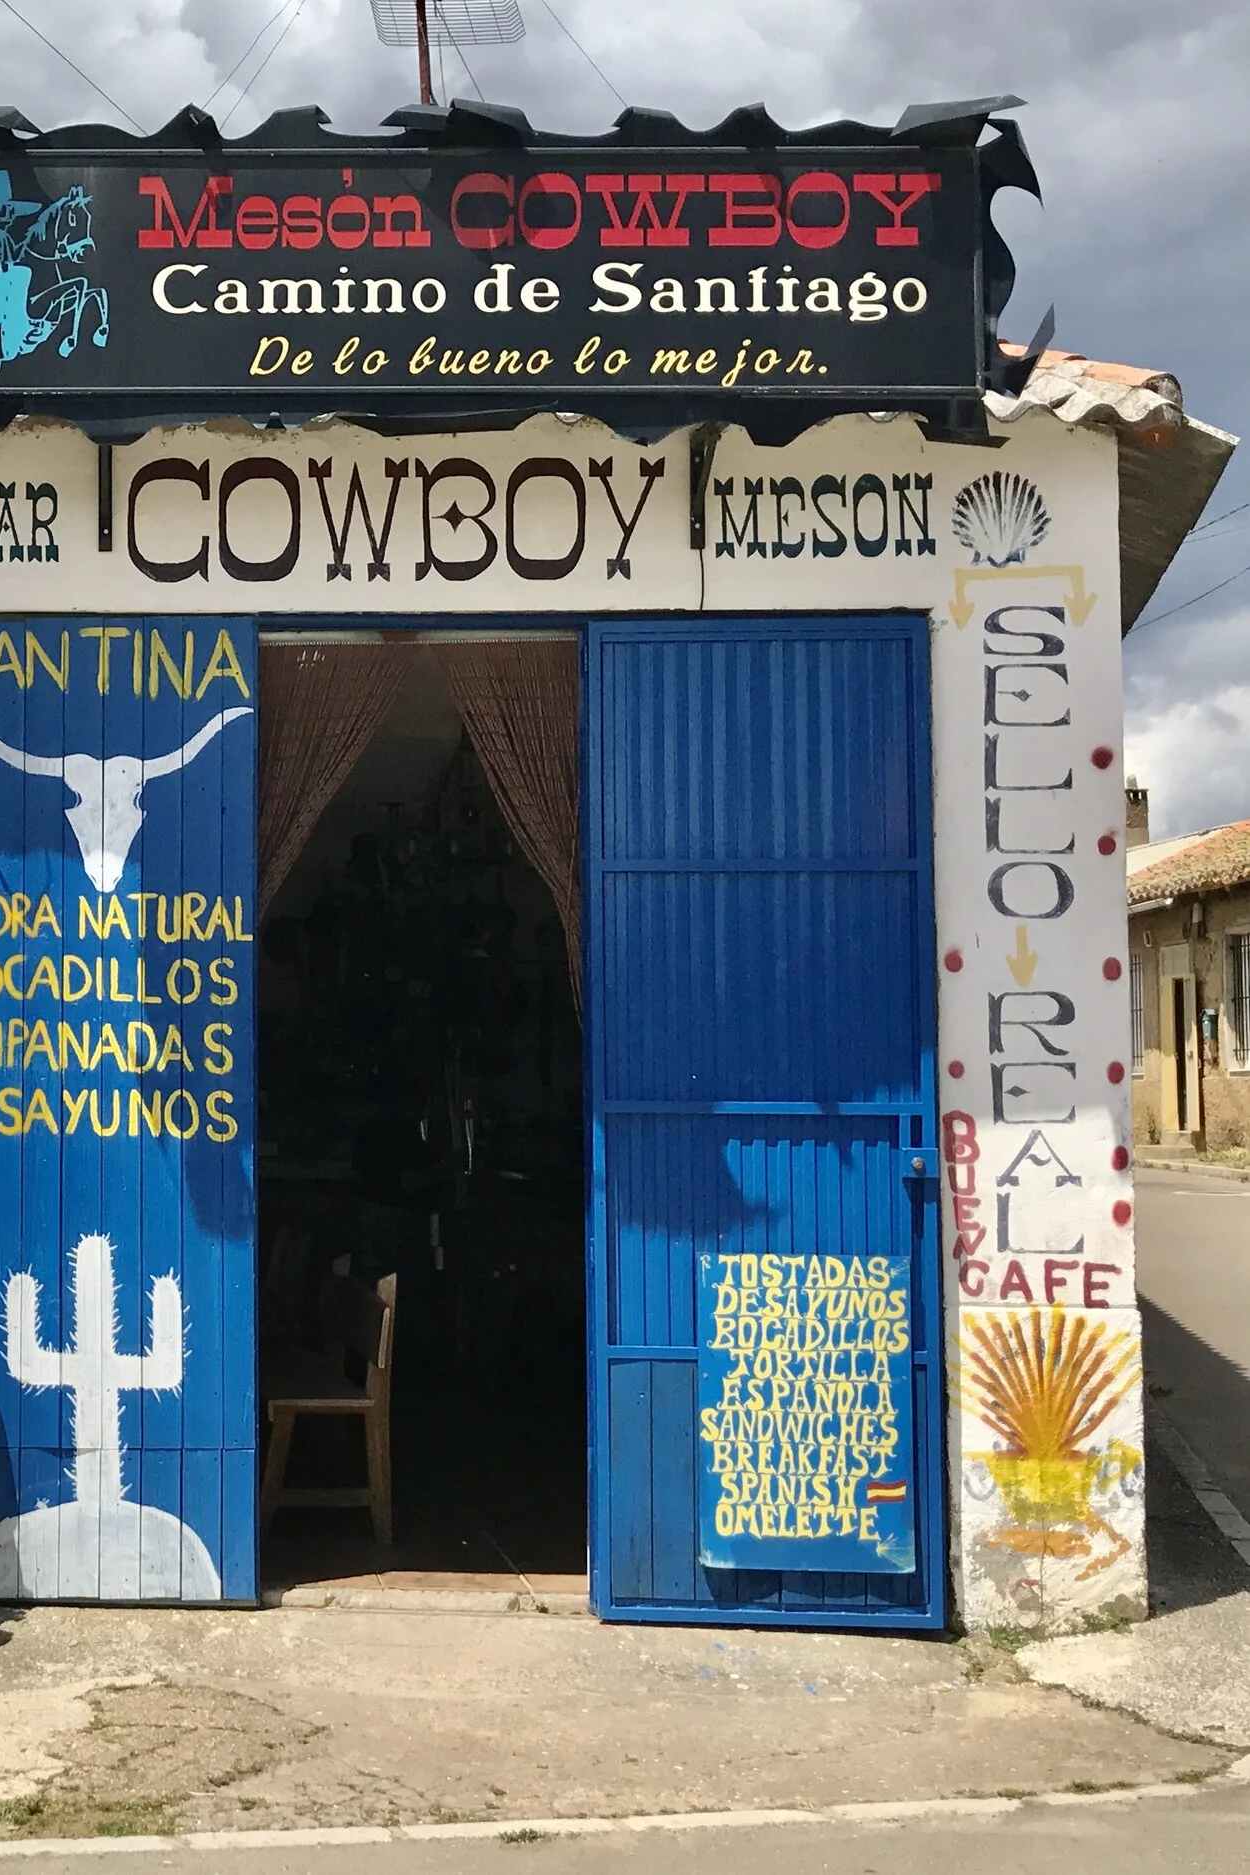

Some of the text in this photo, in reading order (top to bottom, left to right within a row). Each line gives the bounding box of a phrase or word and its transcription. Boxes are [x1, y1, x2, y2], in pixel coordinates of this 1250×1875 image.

[137, 167, 942, 250] Mesón COWBOY
[152, 262, 928, 322] Camino de Santiago
[249, 336, 829, 388] De lo bueno lo mejor.
[128, 457, 665, 583] COWBOY
[713, 472, 936, 559] MESON
[79, 890, 254, 944] NATURAL
[982, 605, 1085, 1255] SELLO REAL
[718, 1253, 891, 1290] TOSTADAS
[958, 1259, 1123, 1309] CAFE
[712, 1283, 907, 1321] DESAYUNOS
[707, 1314, 910, 1354] BOCADILLOS
[727, 1348, 892, 1383] TORTILLA
[700, 1407, 899, 1447] SANDWICHES
[708, 1440, 898, 1479] BREAKFAST
[718, 1472, 860, 1509] SPANISH
[715, 1503, 882, 1541] OMELETTE
